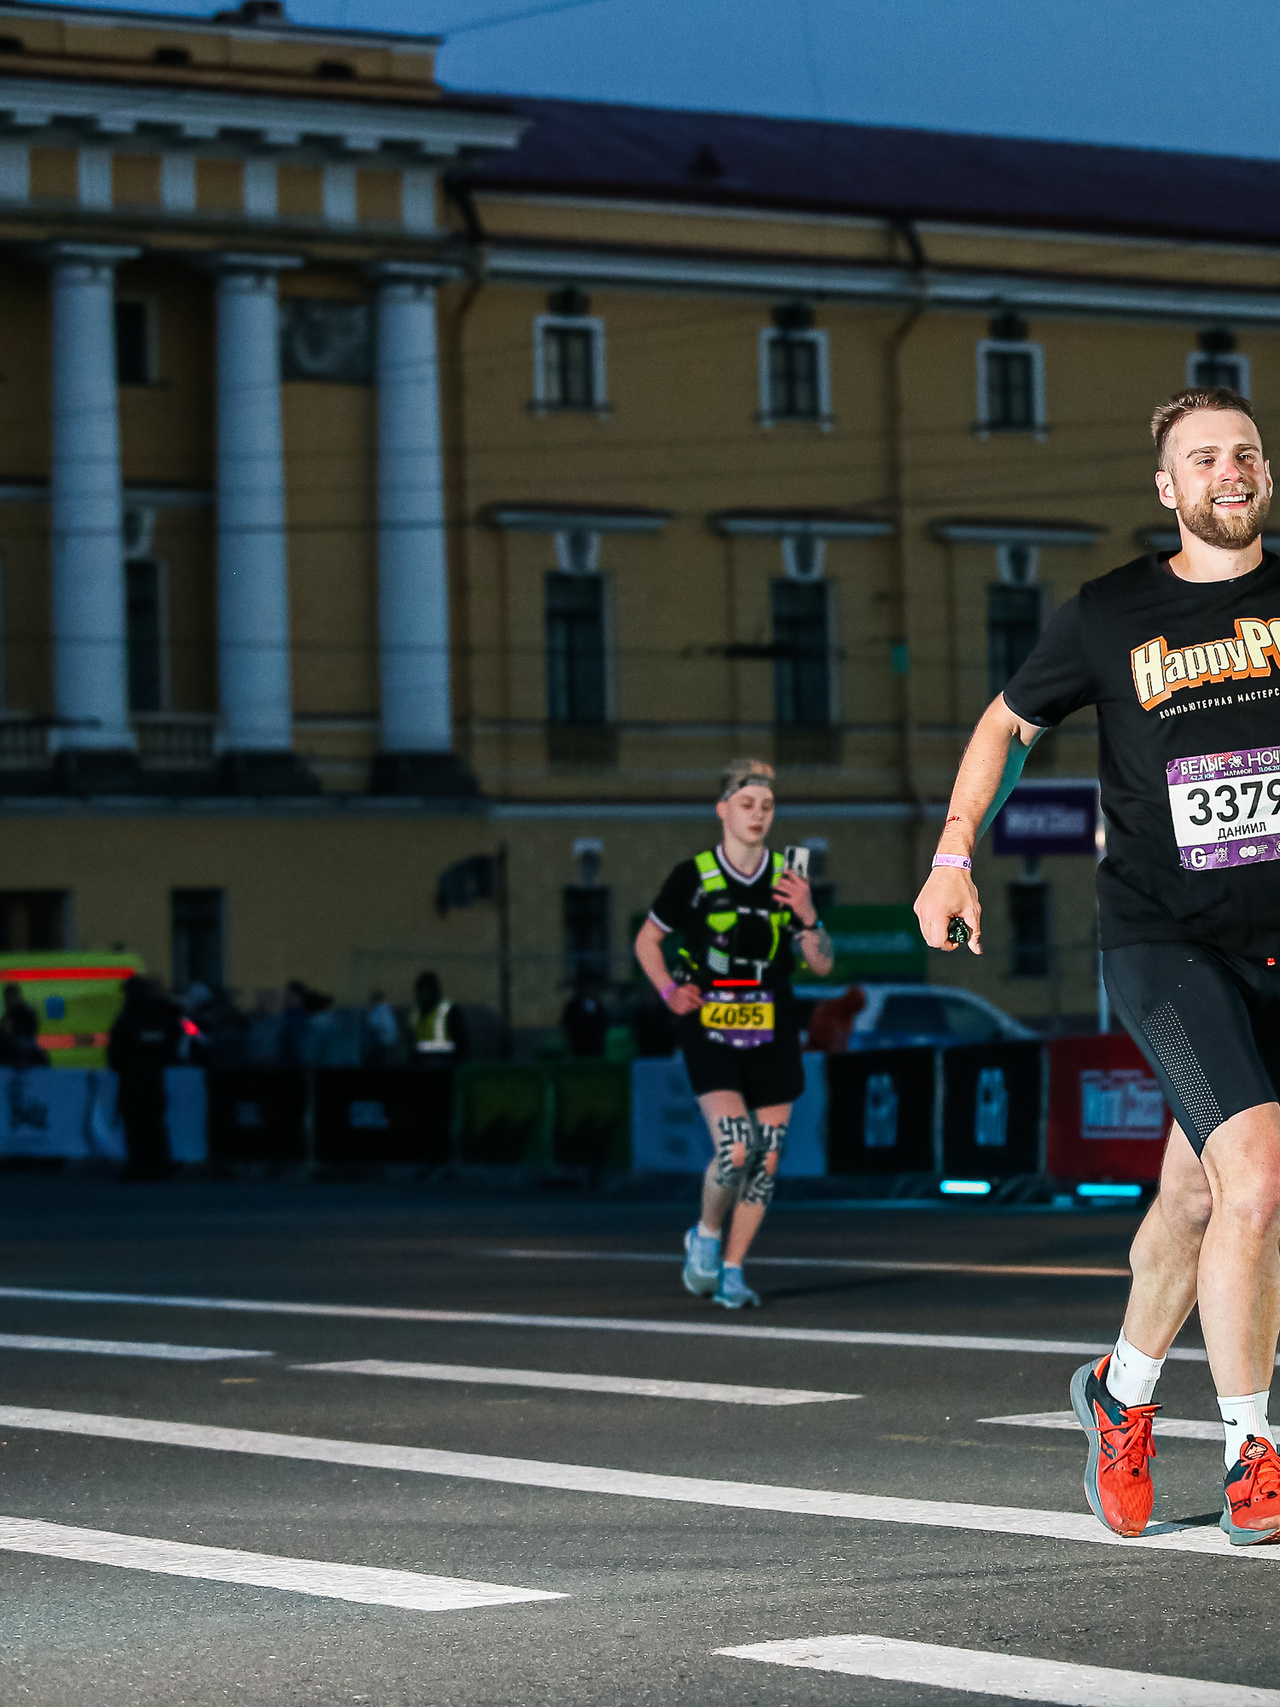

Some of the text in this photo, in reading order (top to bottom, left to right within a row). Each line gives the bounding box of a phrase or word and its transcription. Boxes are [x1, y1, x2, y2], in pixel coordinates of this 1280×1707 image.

[1159, 696, 1233, 719] КОМПЬЮТЕРНАЯ
[1180, 756, 1225, 776] БЕЛЫЕ
[1223, 768, 1253, 777] МАРАФОН
[1217, 822, 1267, 840] ДАНИИЛ
[1190, 847, 1207, 868] G
[710, 1006, 765, 1025] 4055
